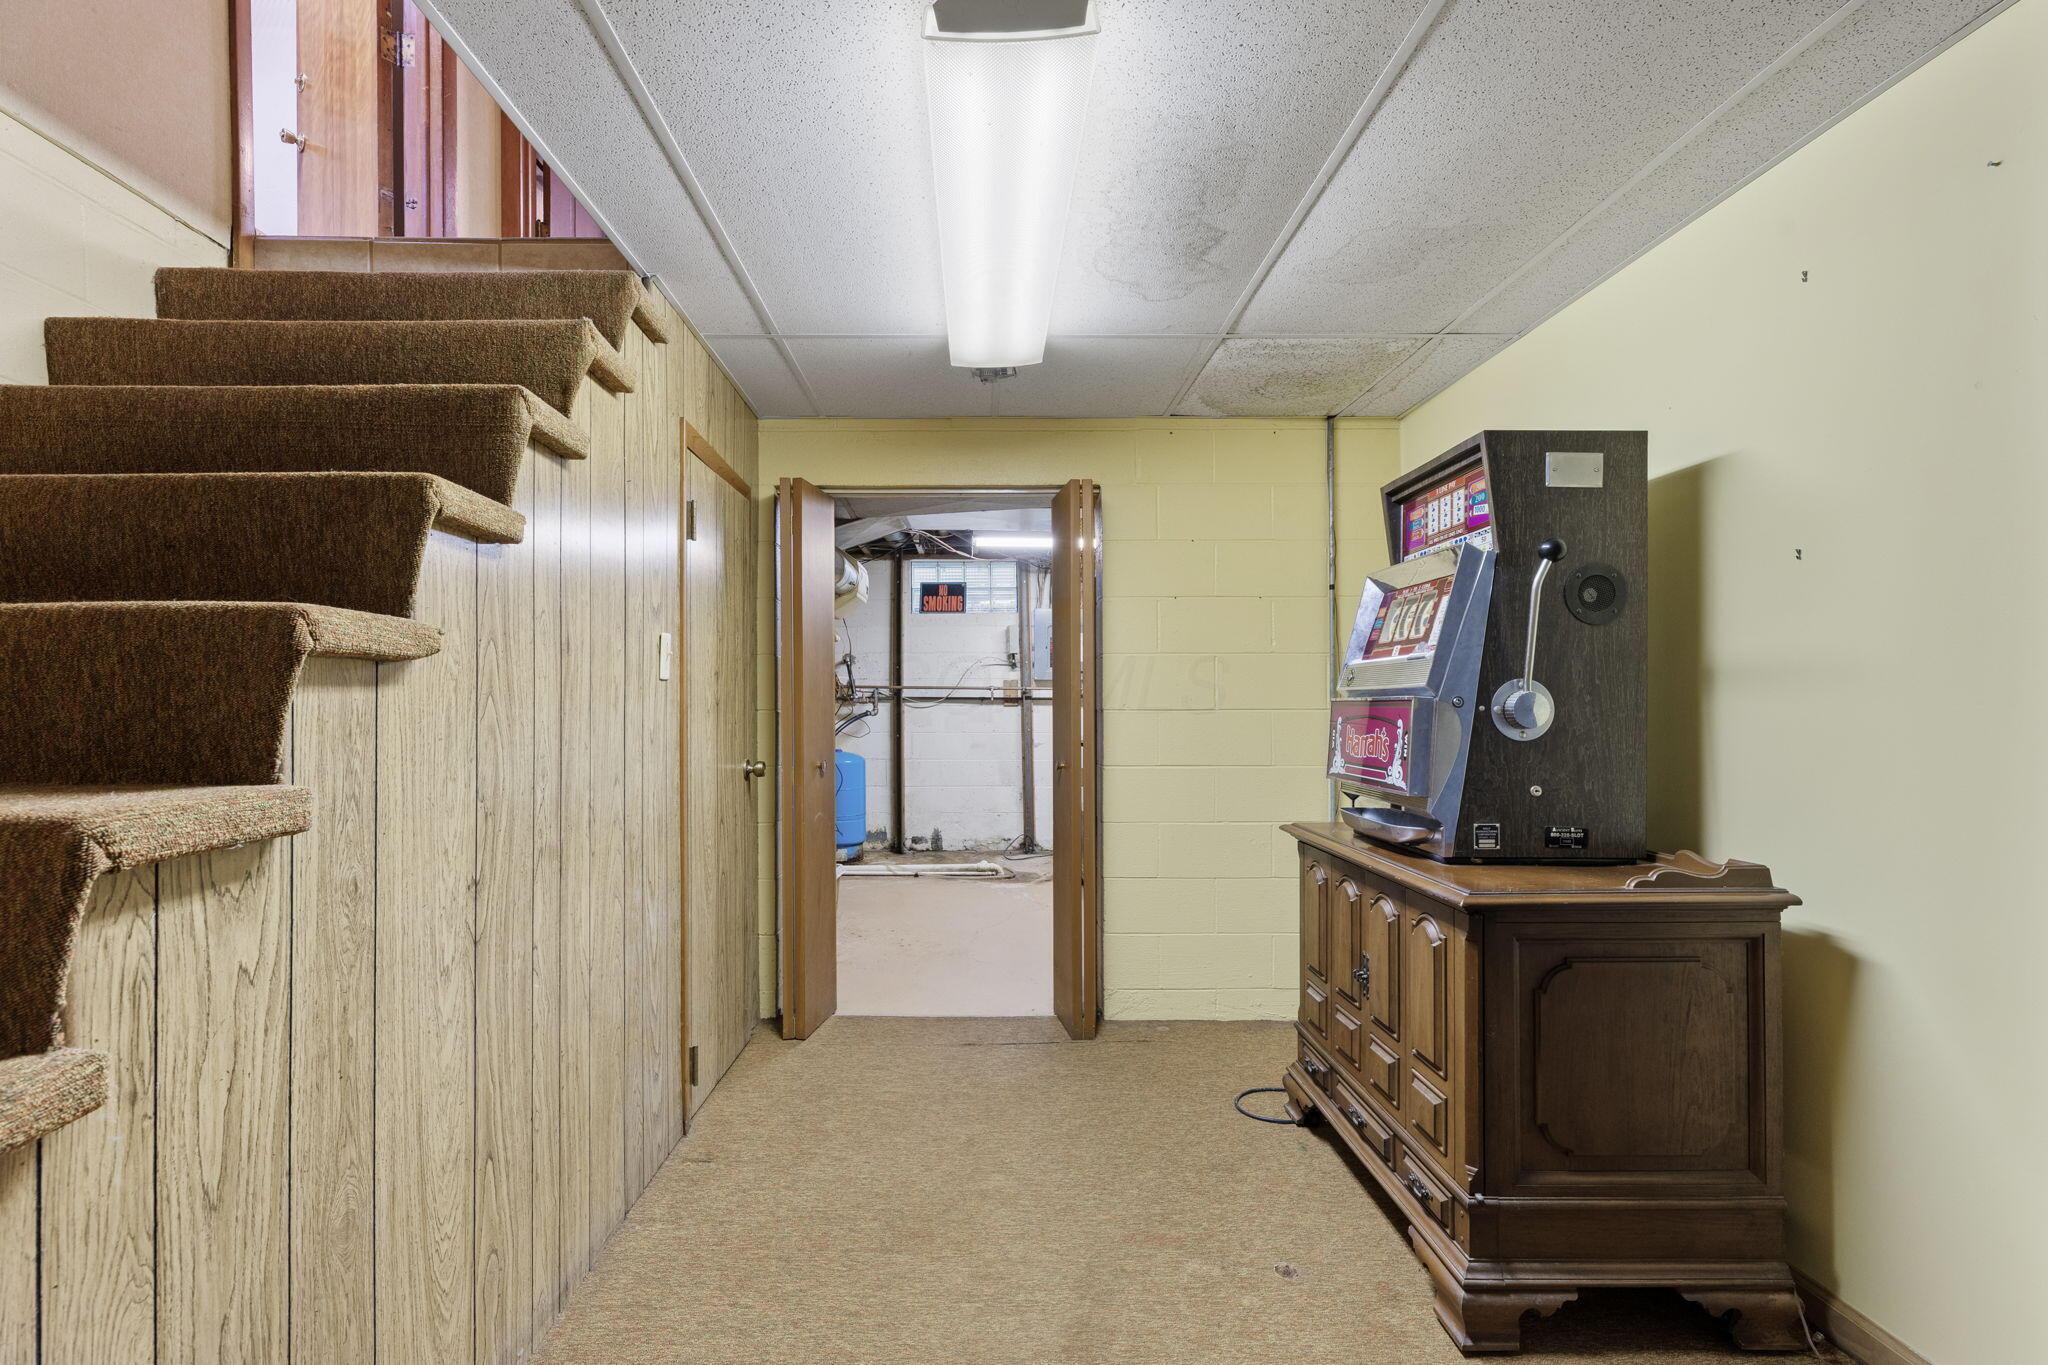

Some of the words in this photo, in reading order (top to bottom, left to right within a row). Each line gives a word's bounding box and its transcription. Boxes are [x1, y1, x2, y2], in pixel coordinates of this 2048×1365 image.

[938, 584, 948, 596] NO
[923, 595, 963, 612] SMOKING
[1346, 724, 1389, 762] Harrah's
